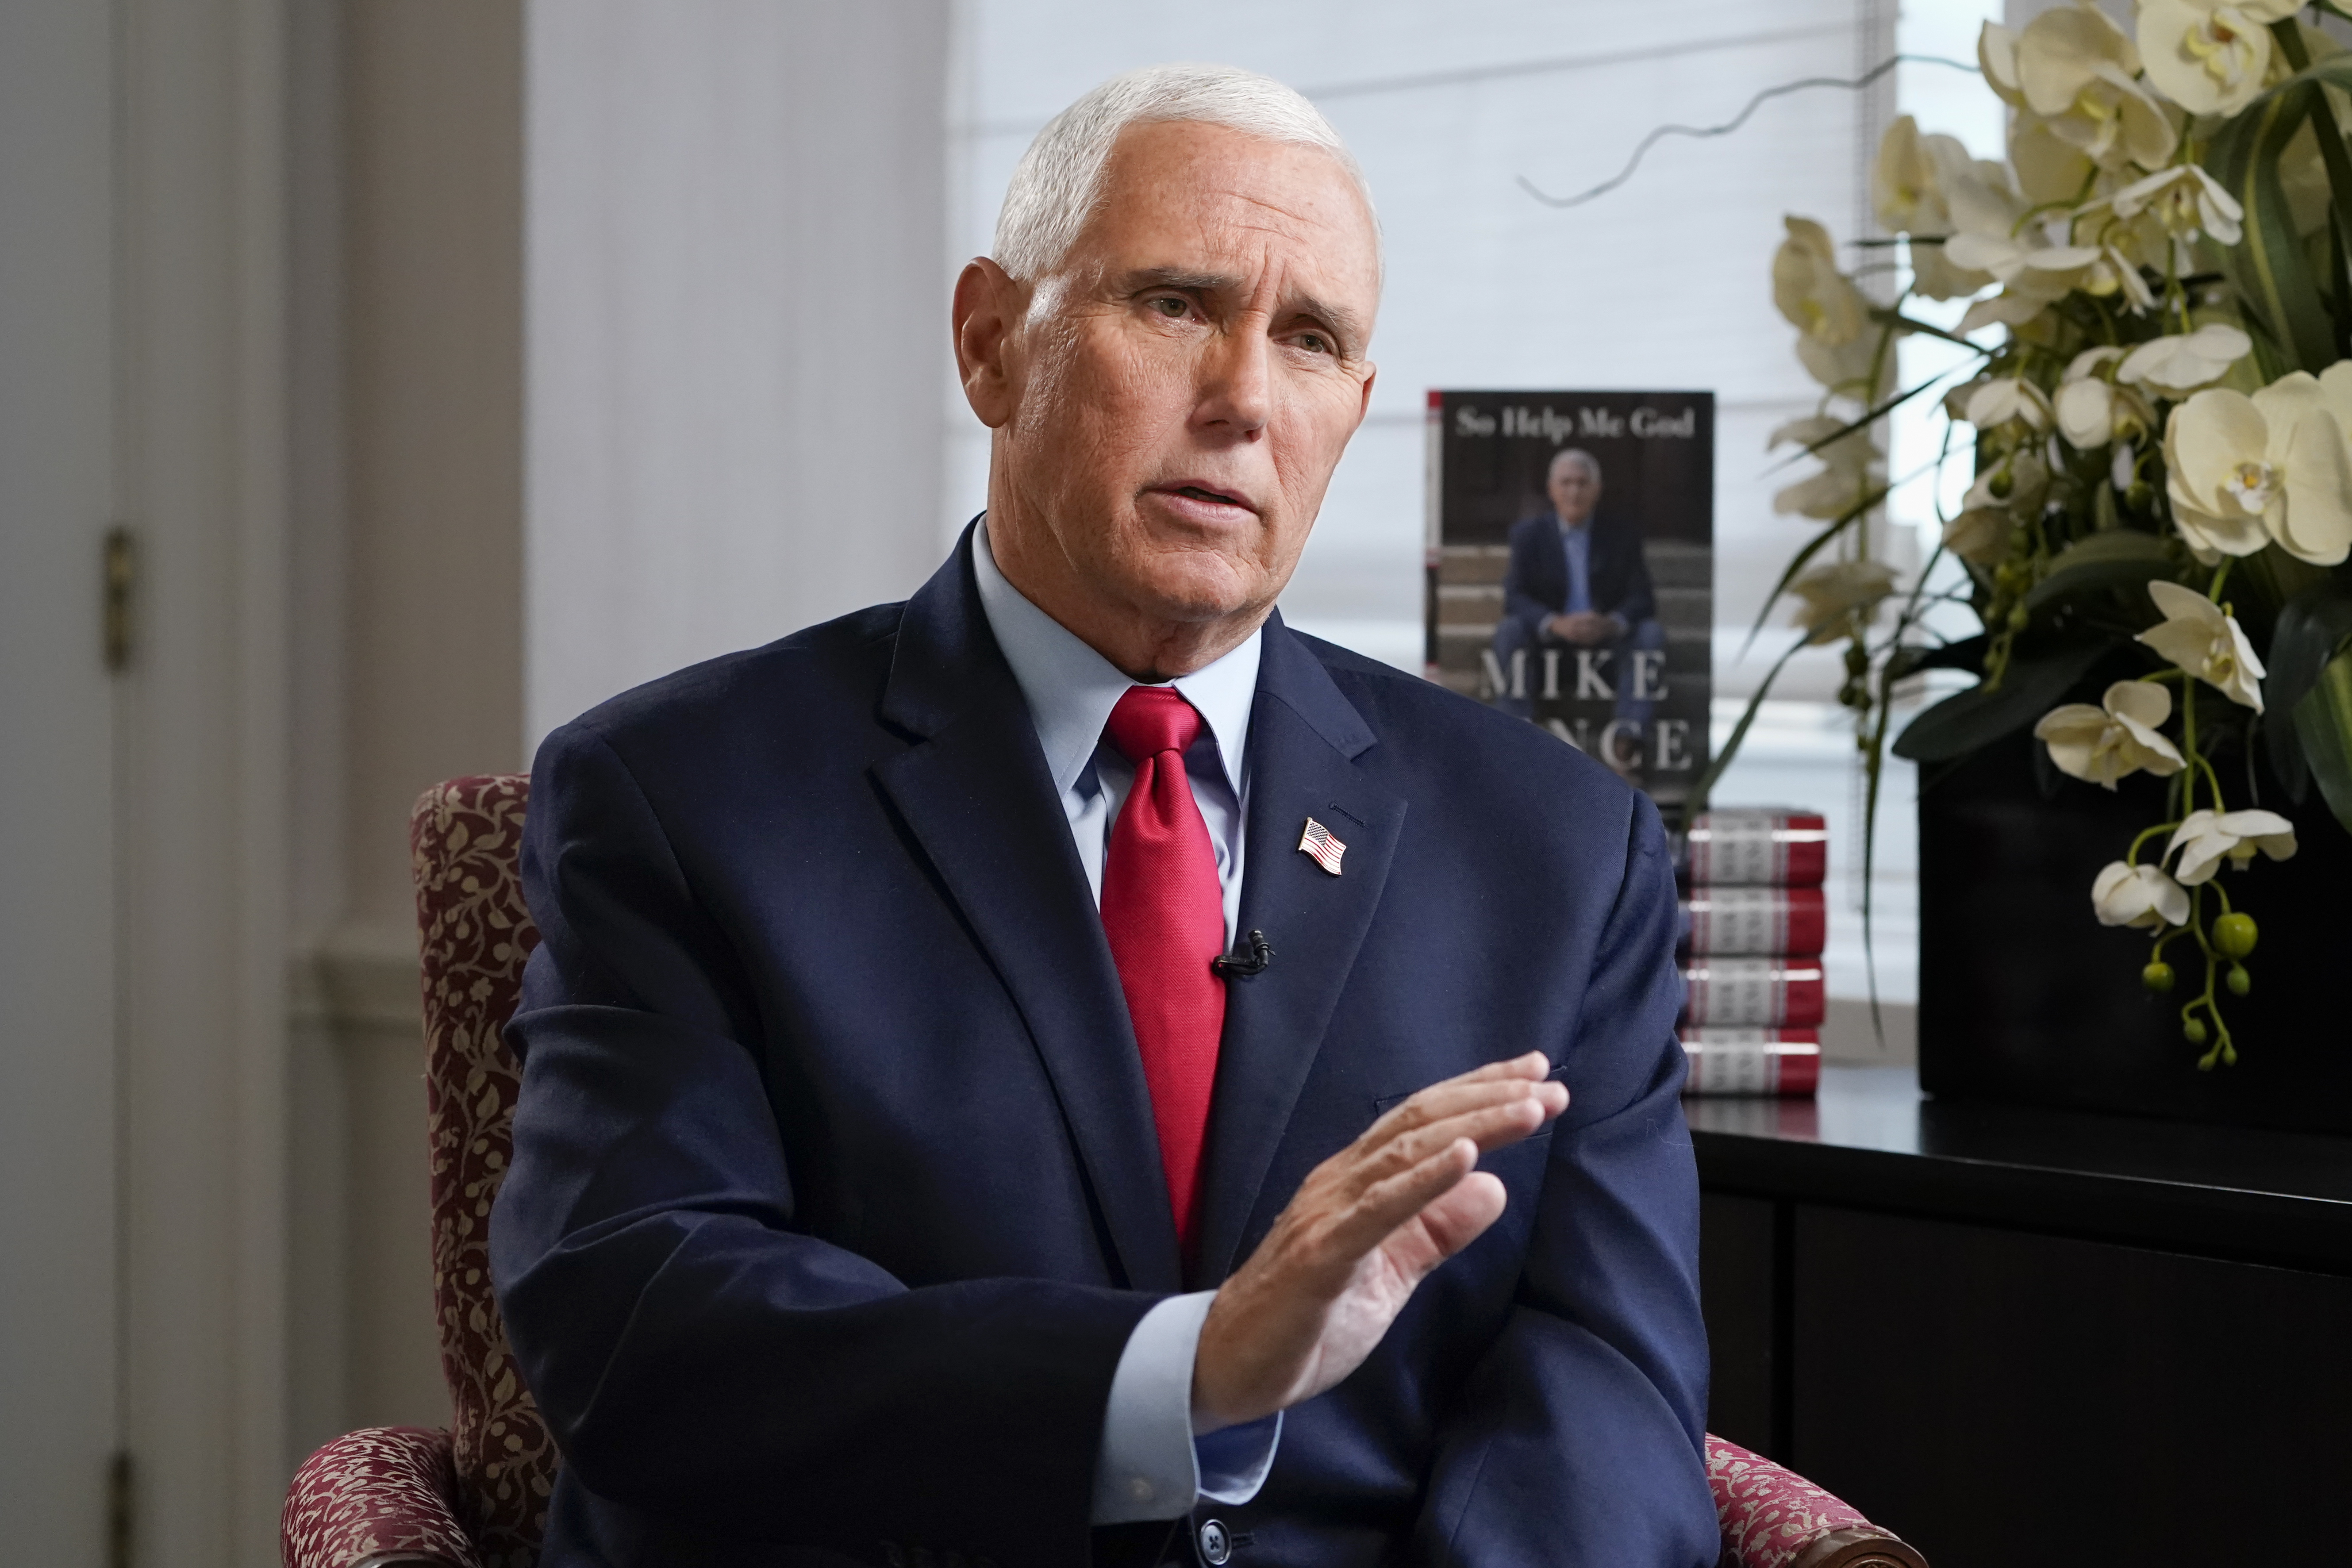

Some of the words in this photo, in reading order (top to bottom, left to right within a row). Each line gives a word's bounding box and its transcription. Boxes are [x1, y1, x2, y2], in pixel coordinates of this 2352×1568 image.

[1456, 406, 1496, 437] So
[1502, 406, 1573, 445] Help
[1579, 406, 1625, 438] Me
[1629, 406, 1695, 438] God
[1480, 649, 1669, 700] MIKE
[1522, 717, 1693, 771] NCE
